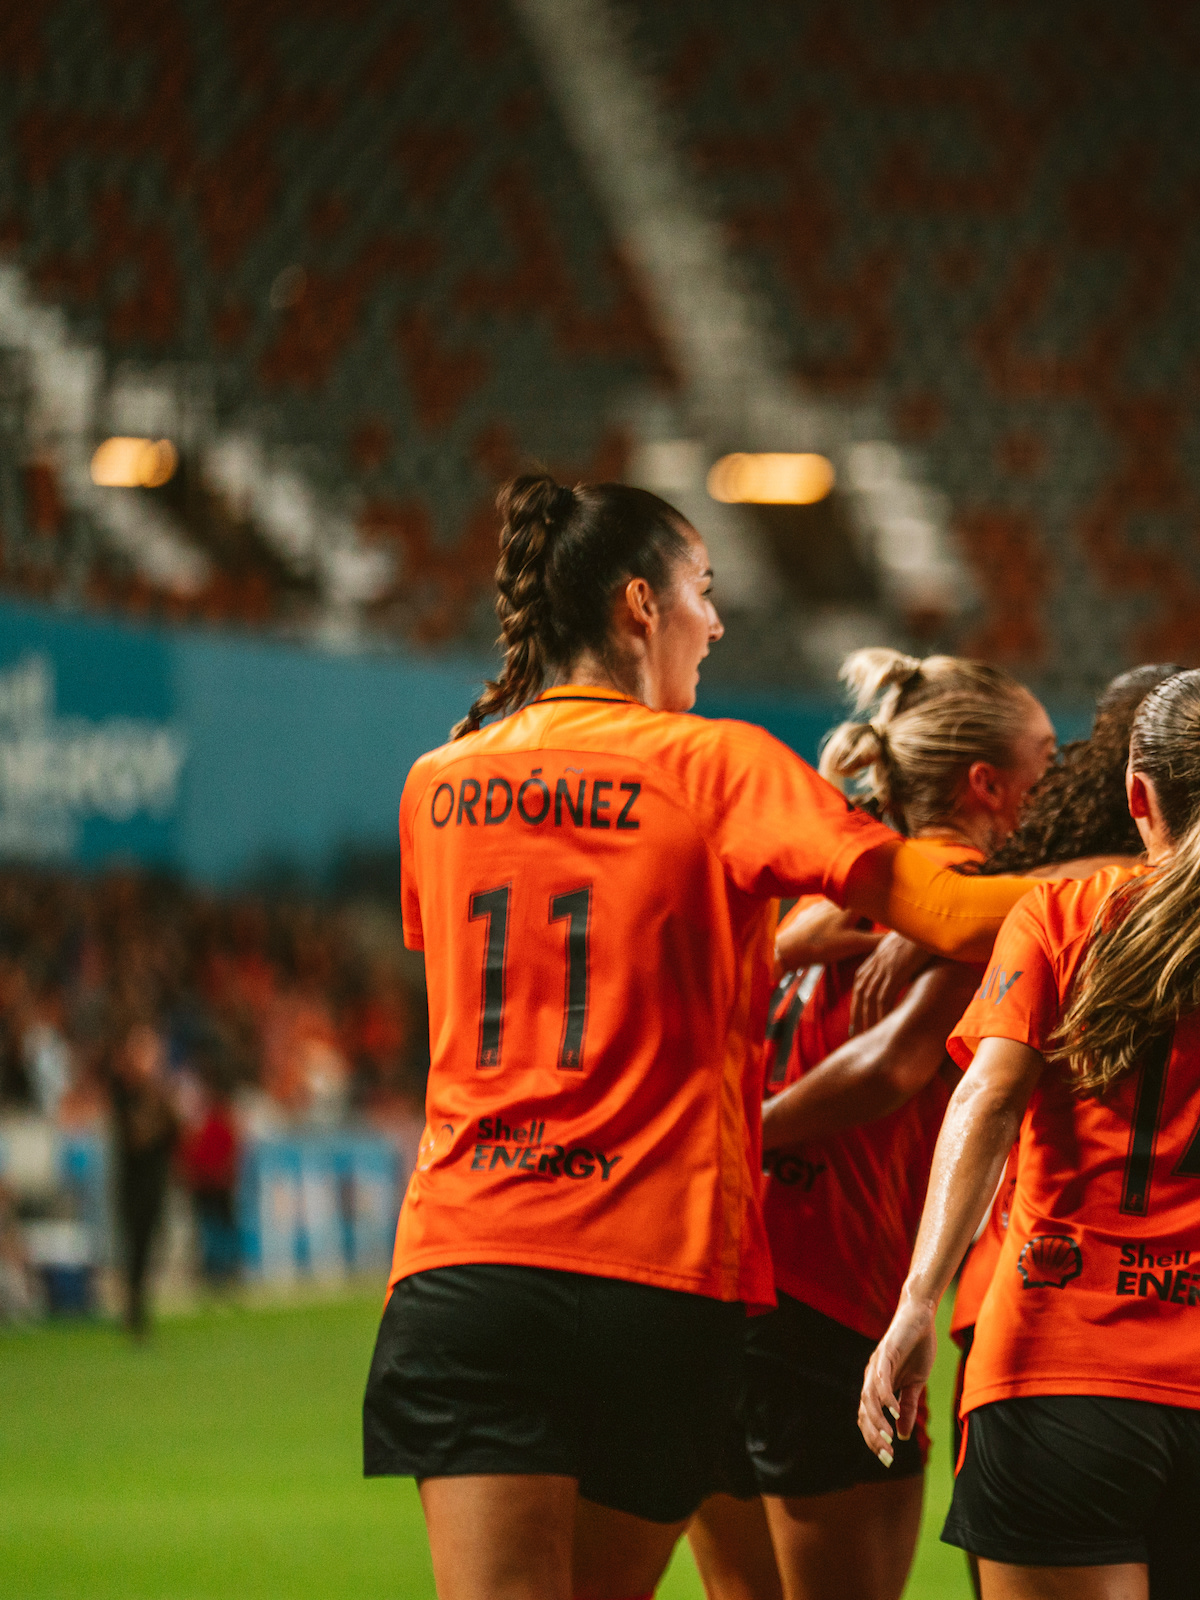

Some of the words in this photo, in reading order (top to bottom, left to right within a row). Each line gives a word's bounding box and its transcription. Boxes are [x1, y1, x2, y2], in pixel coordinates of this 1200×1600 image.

[431, 767, 641, 830] ORDÓÑEZ
[468, 881, 593, 1071] 11
[477, 1117, 545, 1145] Shell
[470, 1144, 623, 1181] ENERGY
[1119, 1243, 1191, 1268] Shell
